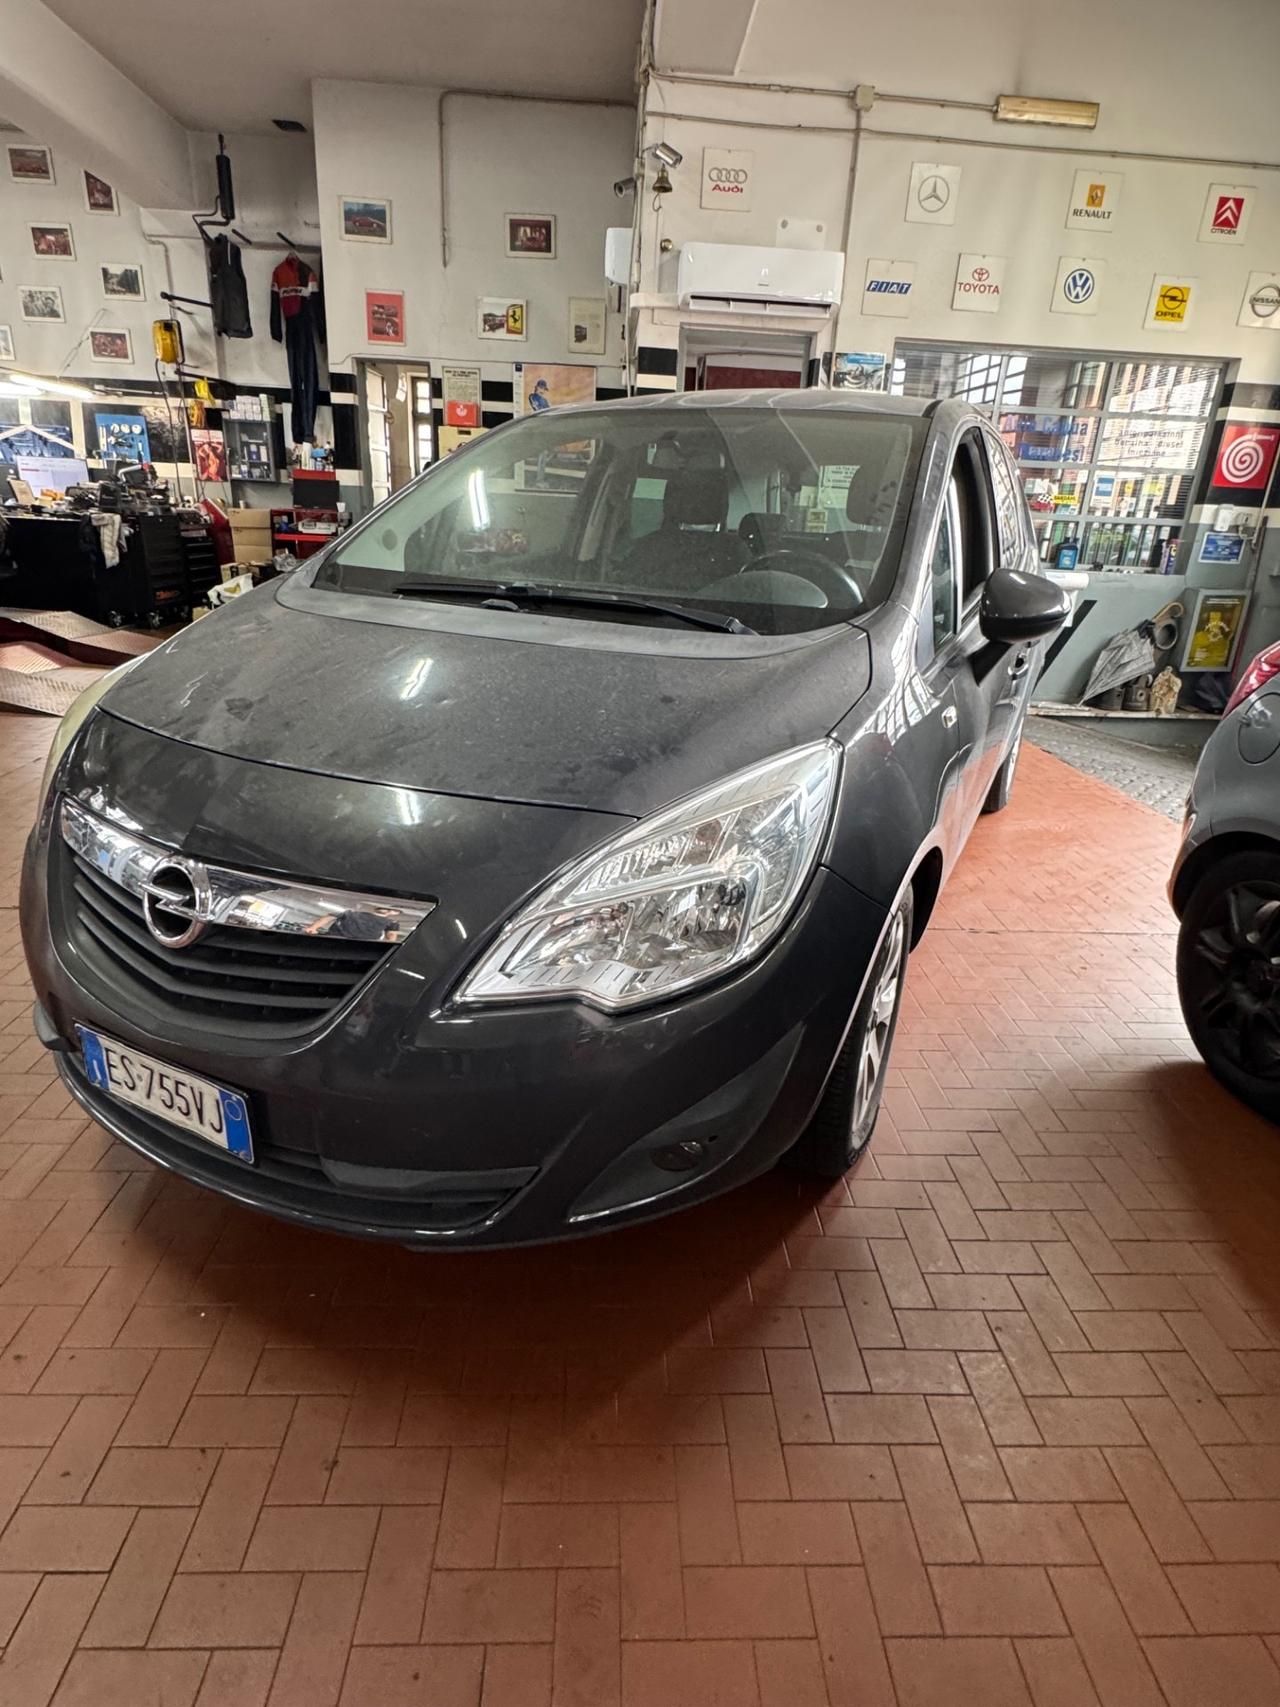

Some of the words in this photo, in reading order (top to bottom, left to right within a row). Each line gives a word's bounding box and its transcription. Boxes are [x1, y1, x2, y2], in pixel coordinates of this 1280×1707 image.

[711, 184, 744, 194] Audi
[1072, 208, 1113, 220] RENAULT
[867, 281, 911, 294] FIAT
[957, 282, 1000, 295] TOYOTA
[1155, 310, 1184, 319] OPEL
